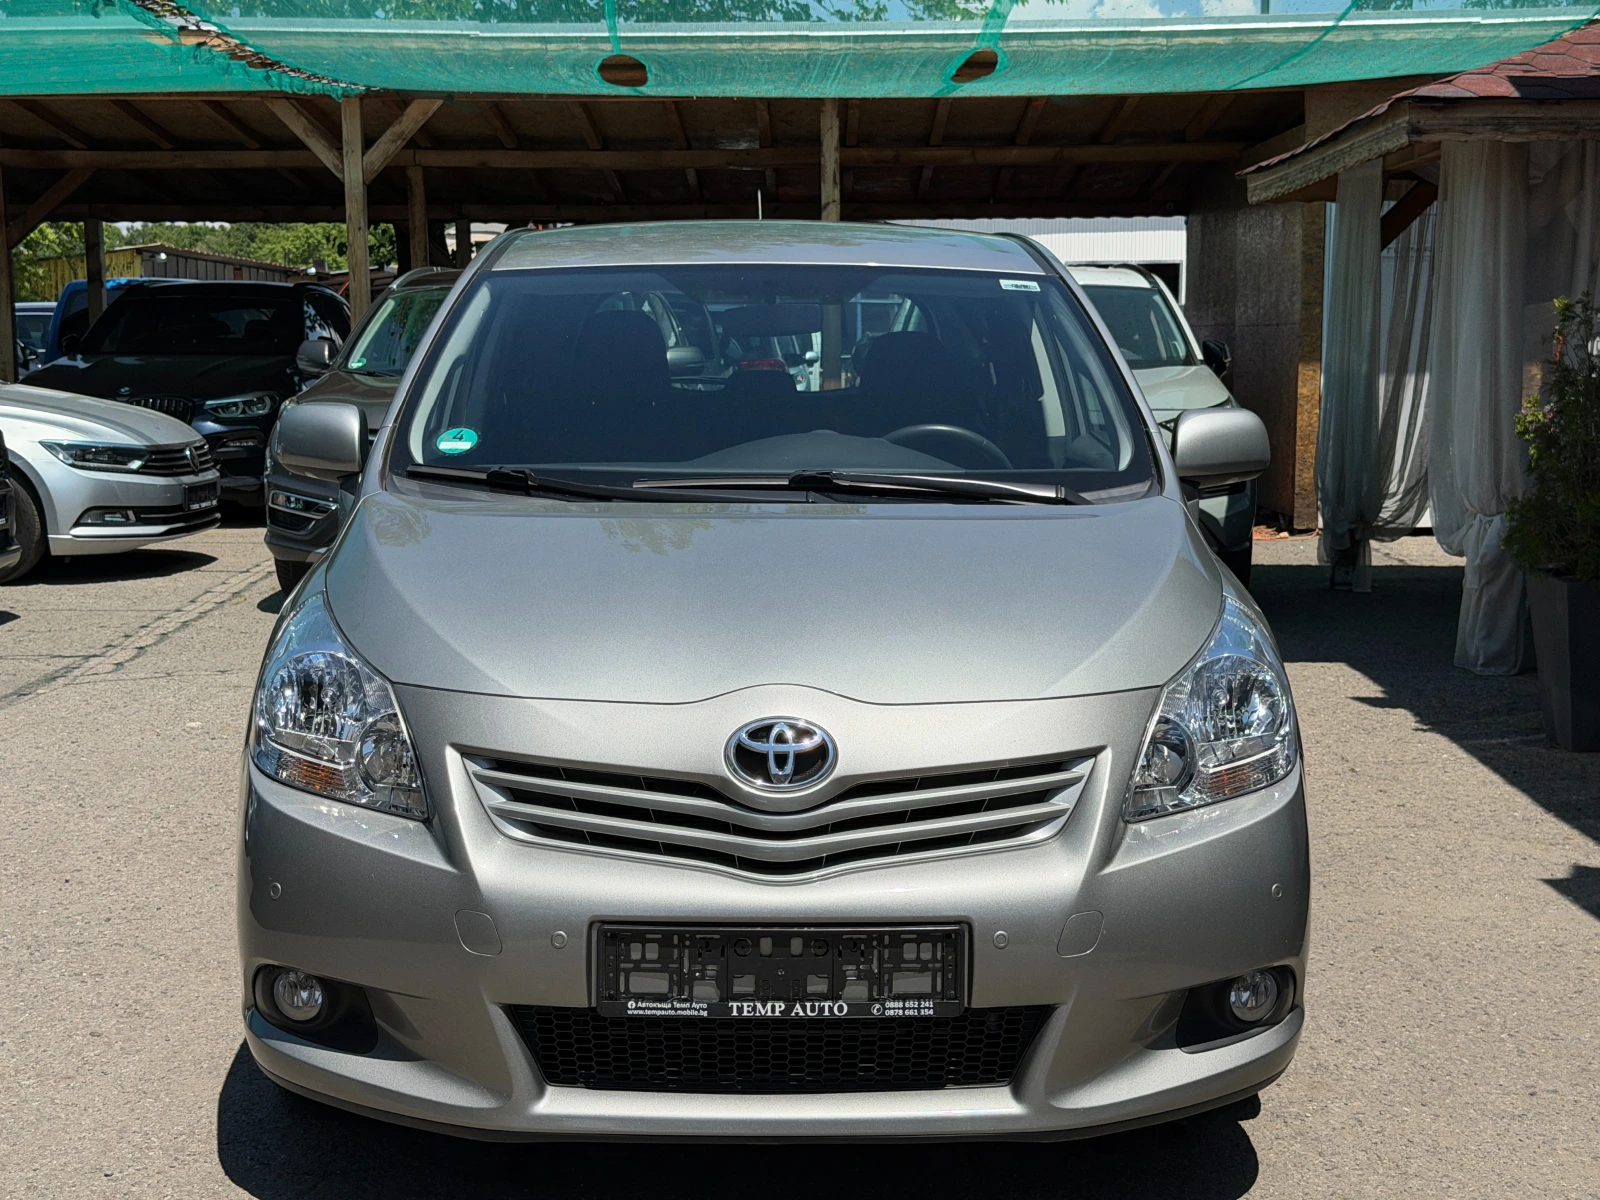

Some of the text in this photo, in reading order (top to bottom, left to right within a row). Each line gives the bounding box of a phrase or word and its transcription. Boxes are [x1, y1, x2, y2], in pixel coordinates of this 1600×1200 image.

[452, 430, 464, 441] 4
[637, 1001, 671, 1009] Автокъща
[691, 1002, 707, 1010] Ауто
[728, 1002, 848, 1016] TEMP AUTO
[627, 1009, 708, 1017] www.tempauto.mobile.bg
